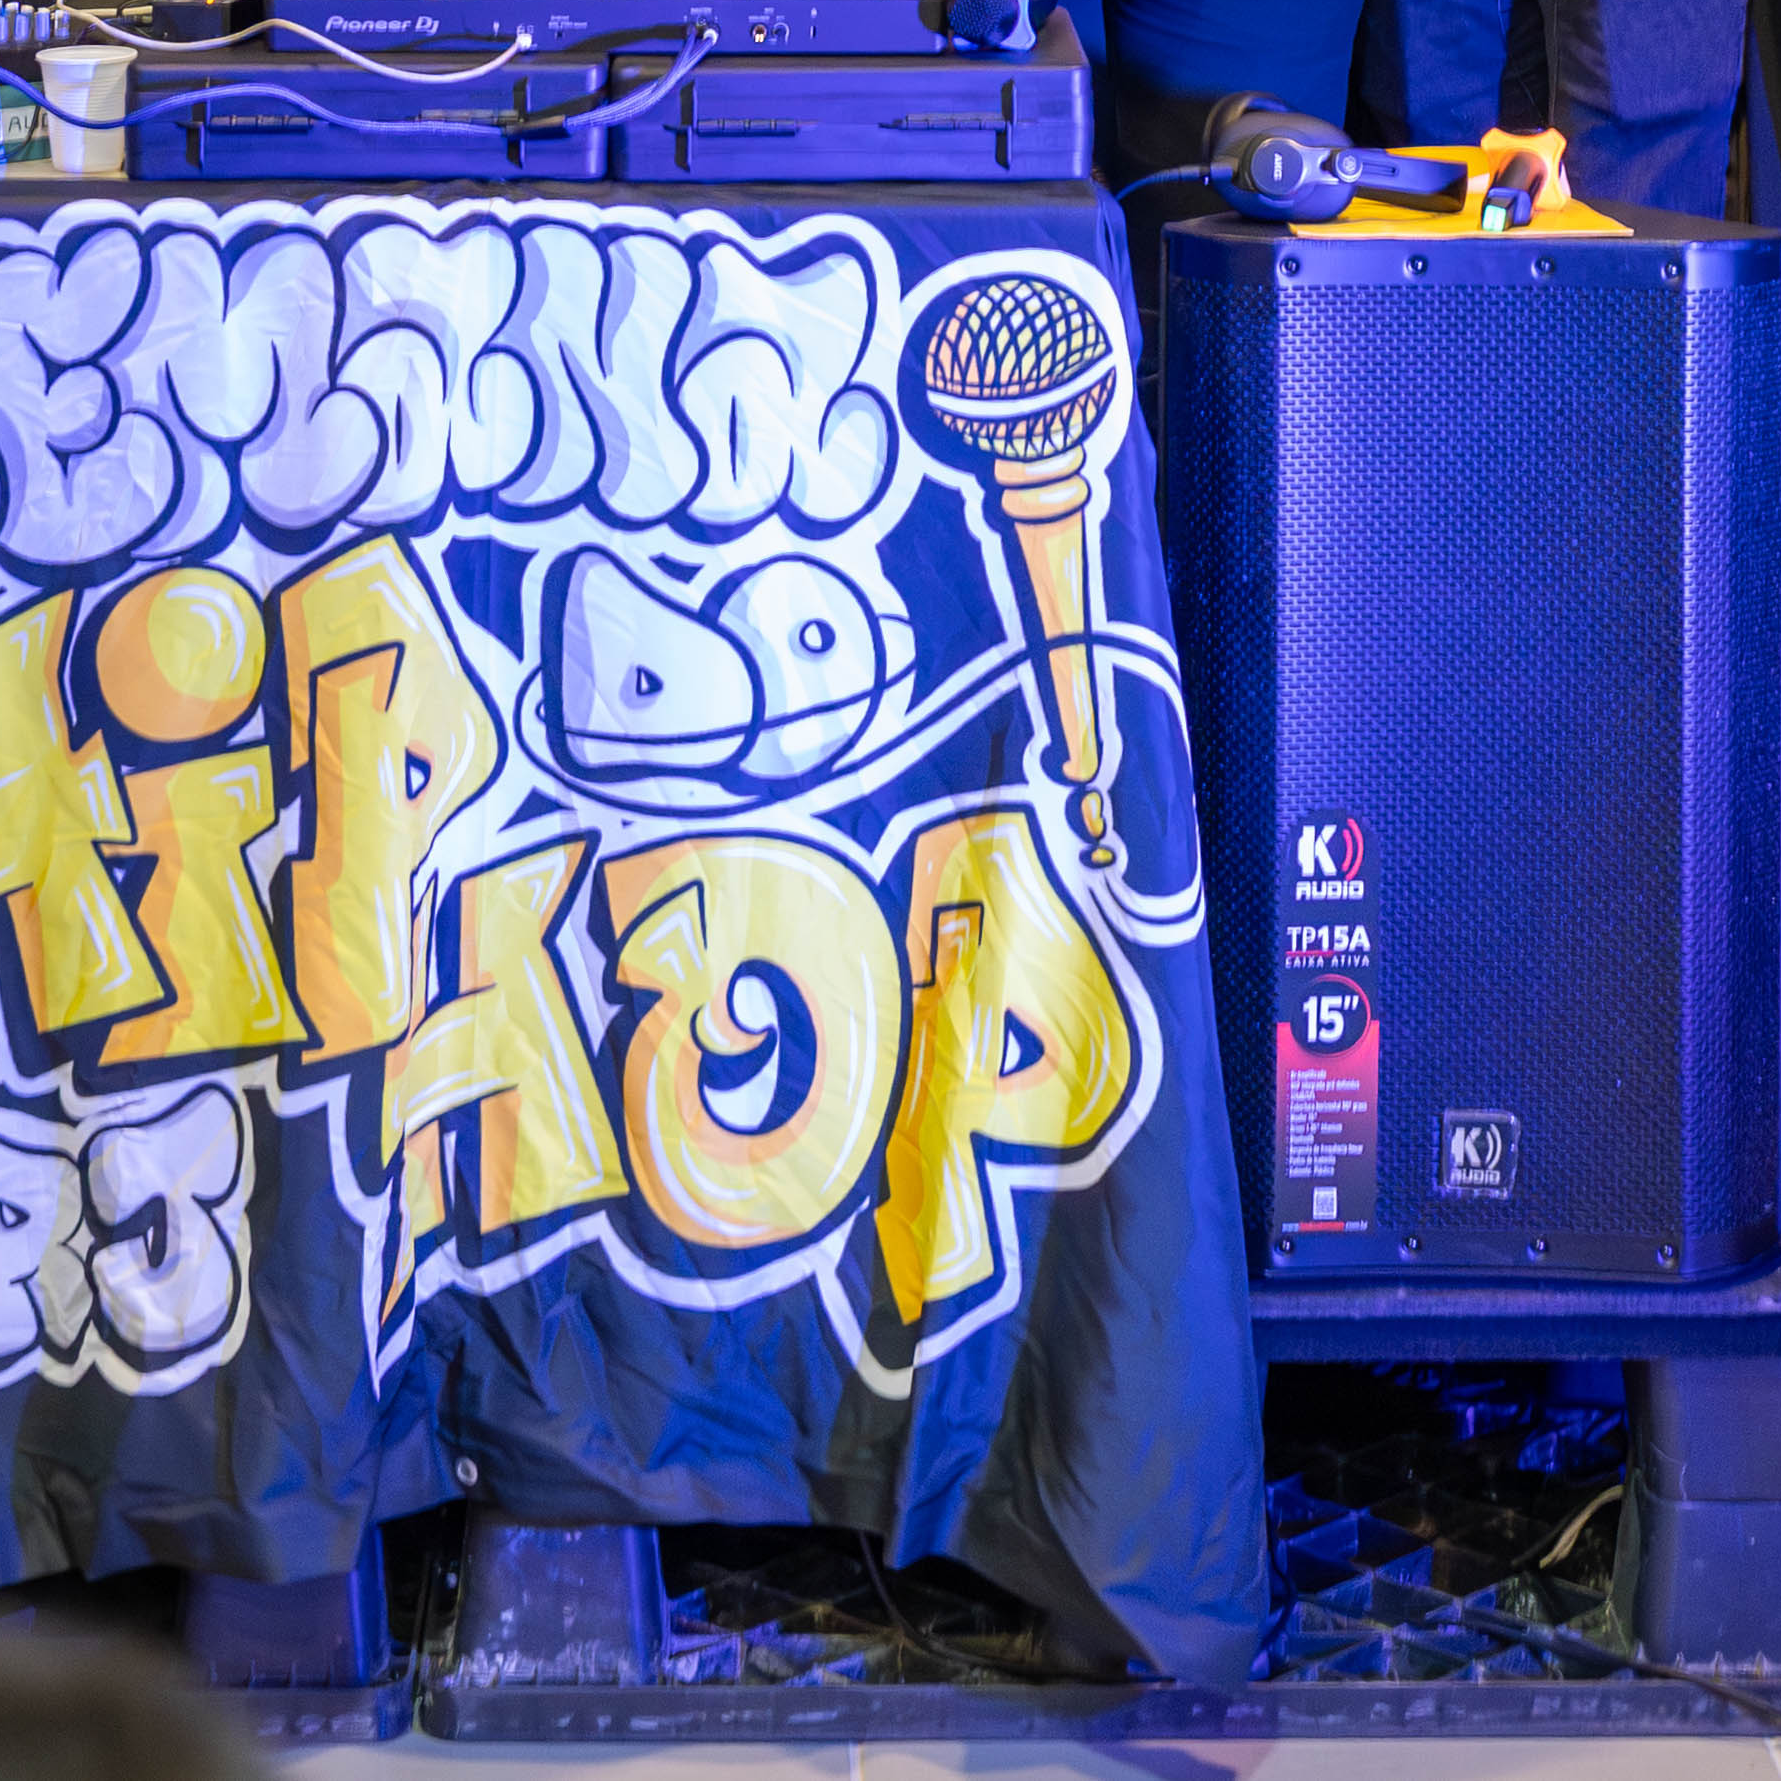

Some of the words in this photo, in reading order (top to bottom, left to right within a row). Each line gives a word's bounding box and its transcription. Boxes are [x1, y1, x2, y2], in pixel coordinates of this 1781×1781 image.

[325, 15, 412, 33] Pioneer
[538, 550, 888, 784] DO
[1286, 924, 1371, 952] TP15A
[1330, 955, 1370, 968] ATIVA
[378, 809, 1138, 1324] HOP
